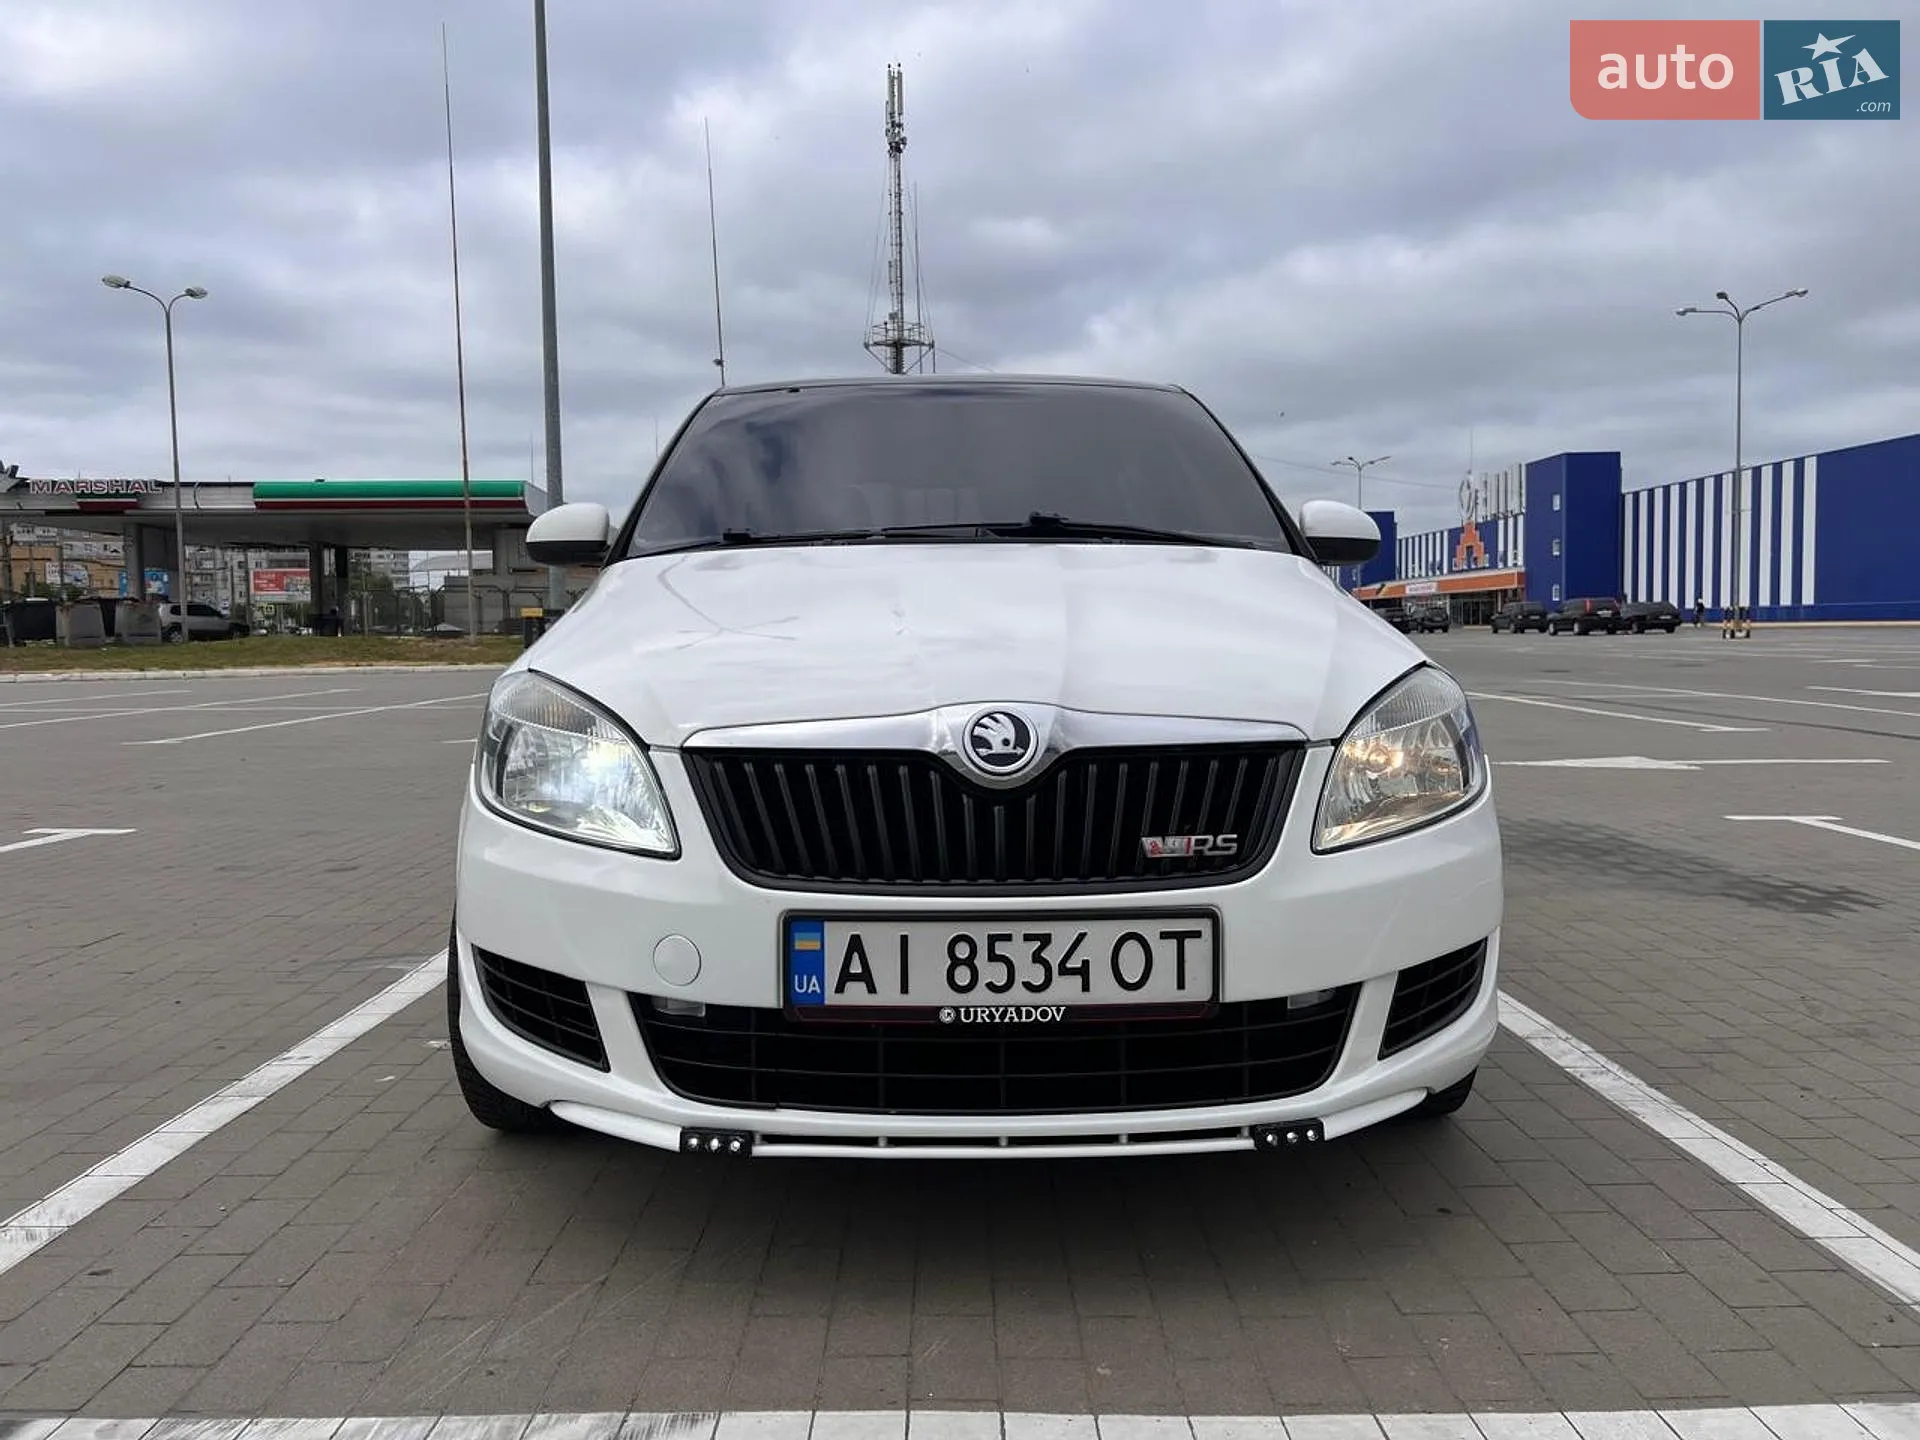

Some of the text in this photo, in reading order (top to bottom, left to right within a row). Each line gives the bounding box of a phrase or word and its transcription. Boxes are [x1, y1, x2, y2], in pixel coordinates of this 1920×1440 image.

[30, 479, 163, 494] MARSHAL
[946, 932, 1090, 994] 8534
[1110, 930, 1202, 992] OT
[794, 975, 821, 994] UA
[960, 1006, 1066, 1023] URYADOV
